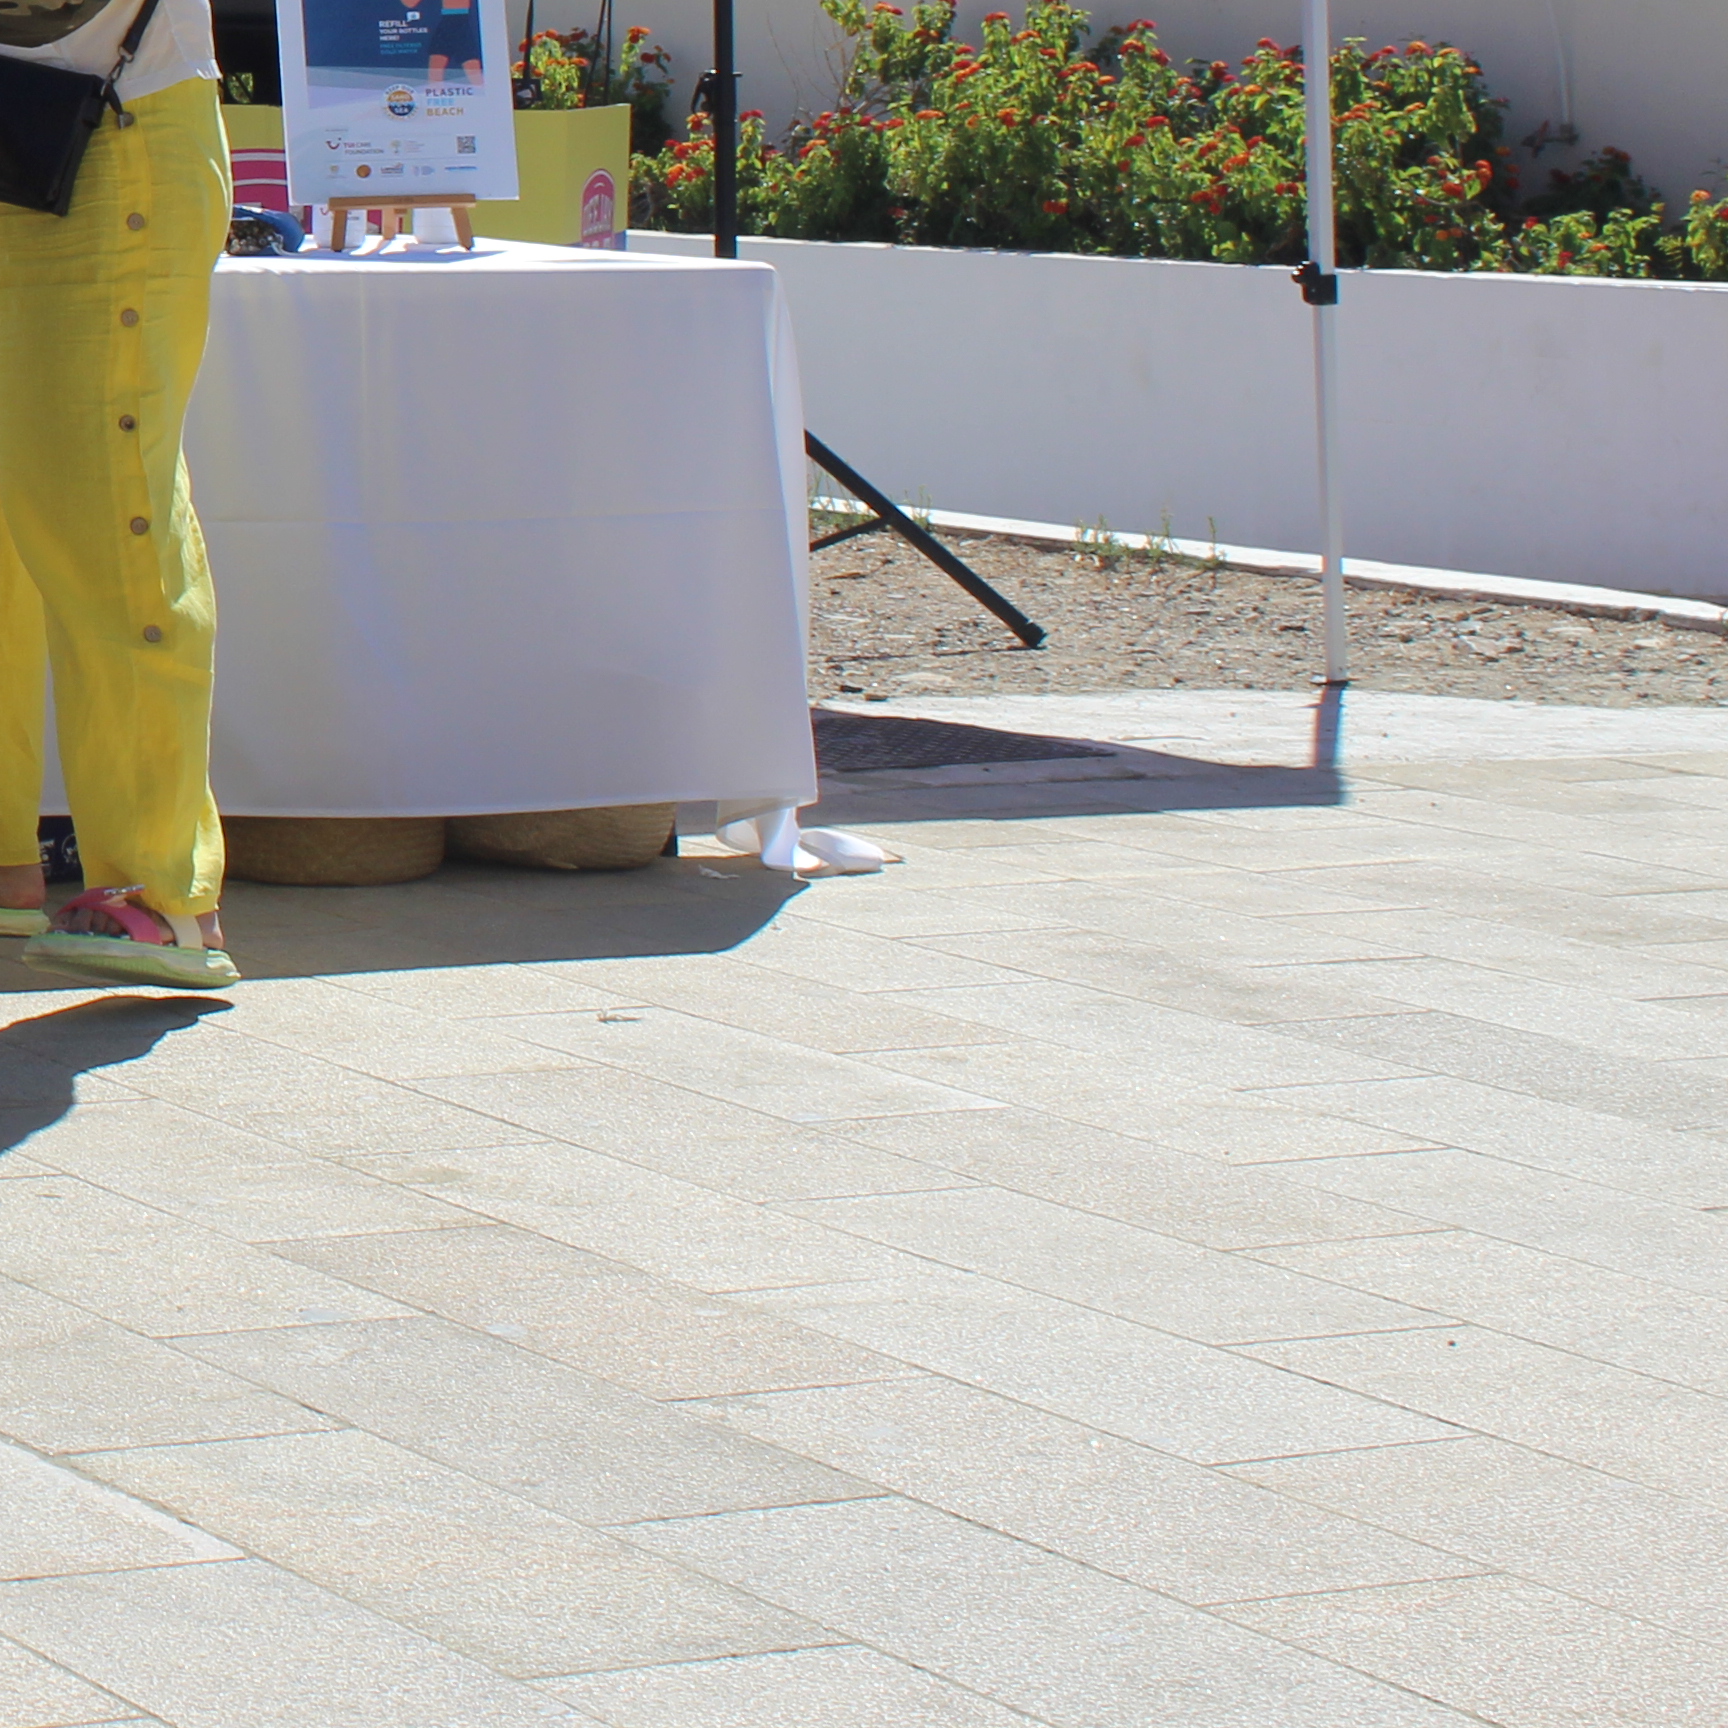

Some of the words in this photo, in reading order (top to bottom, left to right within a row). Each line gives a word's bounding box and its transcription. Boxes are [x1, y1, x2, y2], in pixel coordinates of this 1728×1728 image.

[425, 87, 474, 97] PLASTIC
[427, 98, 455, 106] FREE
[426, 107, 464, 116] BEACH
